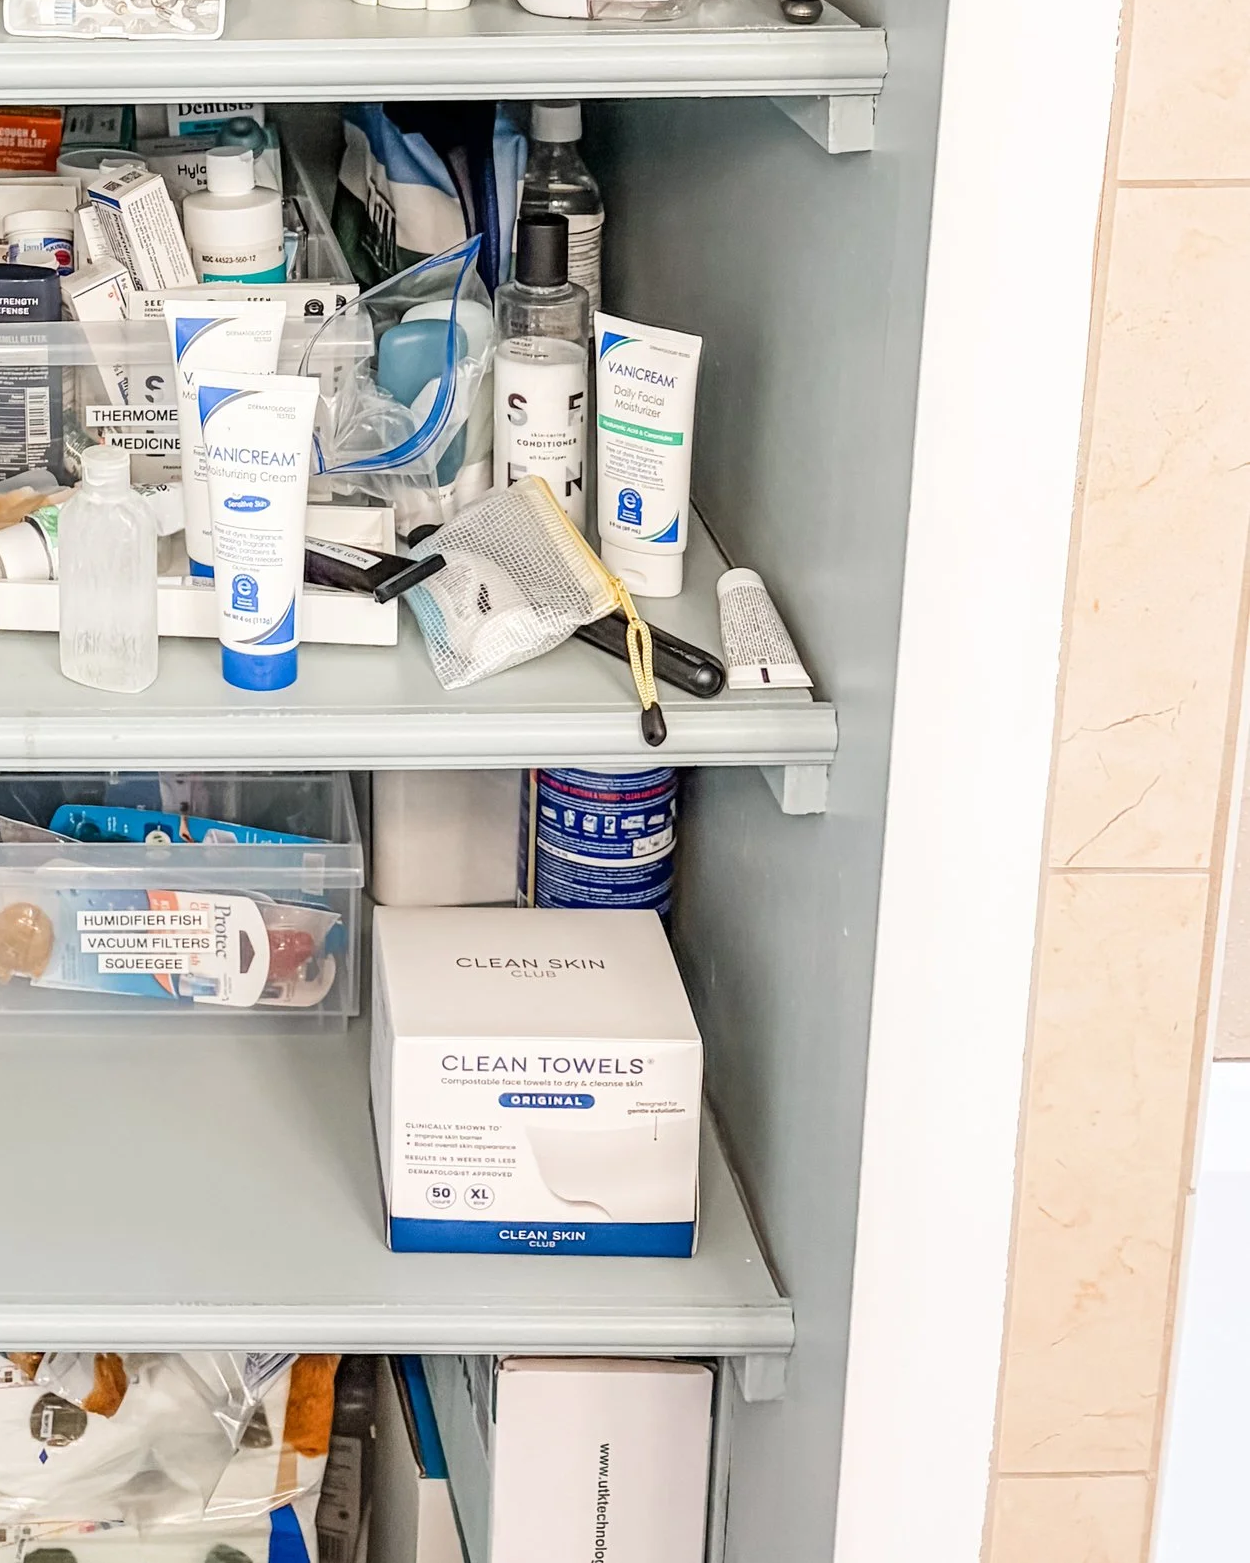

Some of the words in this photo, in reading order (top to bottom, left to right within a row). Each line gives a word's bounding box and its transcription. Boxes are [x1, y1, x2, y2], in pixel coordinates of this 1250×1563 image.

[177, 103, 254, 117] Dentists
[31, 128, 37, 138] &
[17, 138, 48, 149] RELIEF
[202, 255, 214, 264] NDC
[607, 360, 676, 389] VANICREAM
[613, 385, 637, 401] Daily
[638, 390, 666, 407] Facial
[247, 403, 297, 414] DERMATOLOGIST
[614, 399, 662, 419] Moisturizer
[275, 413, 297, 421] TESTED
[626, 426, 638, 435] Acid
[516, 438, 578, 449] CONDITIONER
[206, 442, 297, 466] VANICREAM
[260, 472, 298, 484] Cream
[227, 500, 253, 509] Sensitive
[254, 500, 269, 509] Skin
[326, 544, 342, 556] FACE
[344, 551, 370, 565] LOTION
[84, 915, 166, 927] HUMIDIFIER
[170, 915, 202, 926] FISH
[214, 903, 231, 959] Protec
[88, 938, 148, 949] VACUUM
[152, 937, 210, 949] FILTERS
[105, 958, 183, 970] SQUEEGEE
[456, 957, 538, 970] CLEAN
[548, 958, 606, 970] SKIN
[510, 970, 557, 978] CLUB
[441, 1054, 527, 1073] CLEAN
[537, 1057, 645, 1074] TOWELS
[440, 1077, 500, 1088] Compostable
[501, 1077, 521, 1086] face
[523, 1078, 551, 1087] towels
[552, 1079, 563, 1087] to
[564, 1079, 579, 1089] dry
[589, 1079, 624, 1087] cleanse
[625, 1079, 643, 1088] skin
[510, 1095, 584, 1107] ORIGINAL
[635, 1100, 665, 1109] Designed
[627, 1107, 649, 1115] gentle
[650, 1107, 686, 1115] exfoliation
[405, 1122, 453, 1131] CLINICALLY
[455, 1124, 486, 1132] SHOWN
[405, 1154, 437, 1162] RESULTS
[457, 1156, 483, 1164] WEEKS
[498, 1157, 517, 1165] LESS
[408, 1168, 469, 1177] DERMATOLOGIST
[472, 1170, 513, 1178] APPROVED
[432, 1187, 451, 1199] 50
[470, 1188, 489, 1200] XL
[499, 1229, 548, 1241] CLEAN
[552, 1230, 586, 1241] SKIN
[528, 1239, 556, 1249] CLUB
